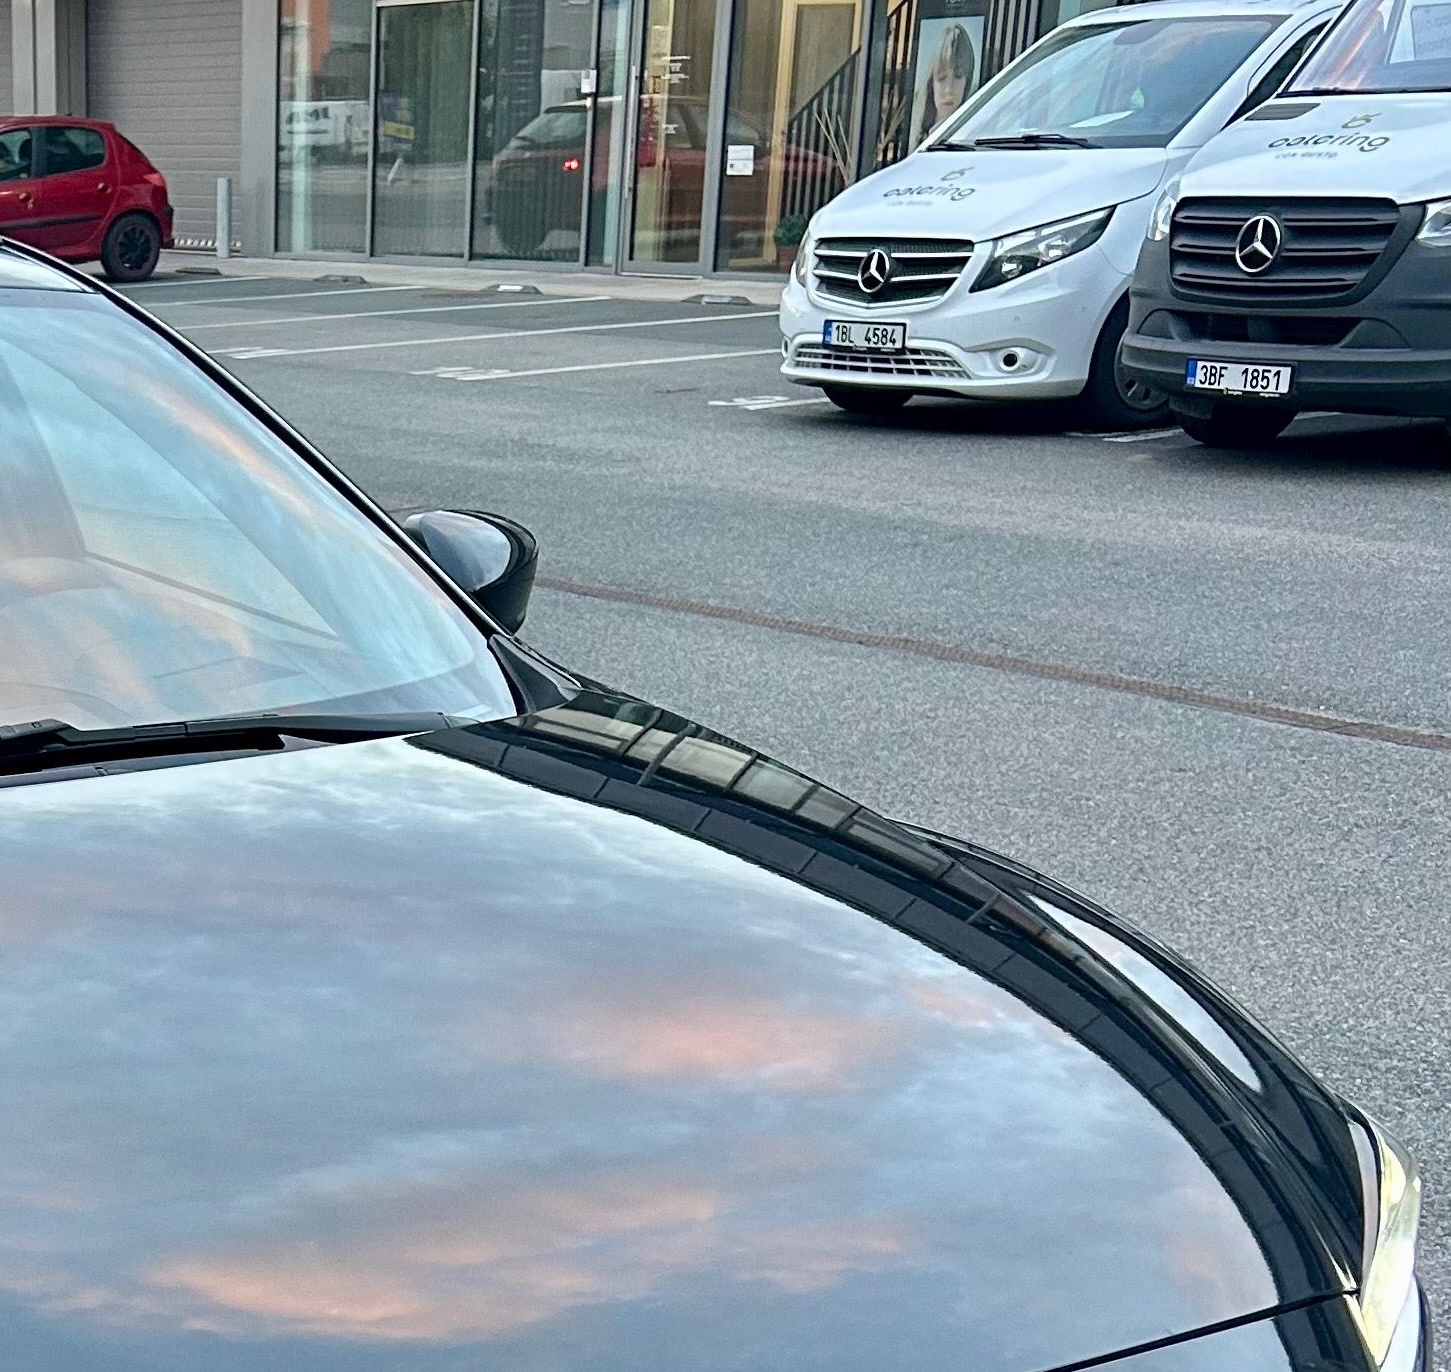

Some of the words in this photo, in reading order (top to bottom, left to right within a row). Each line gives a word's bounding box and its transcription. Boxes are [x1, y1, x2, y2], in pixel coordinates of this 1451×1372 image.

[835, 324, 854, 344] 1BL
[864, 327, 896, 346] 4584
[1199, 365, 1228, 386] 3BF
[1241, 367, 1281, 391] 1851
